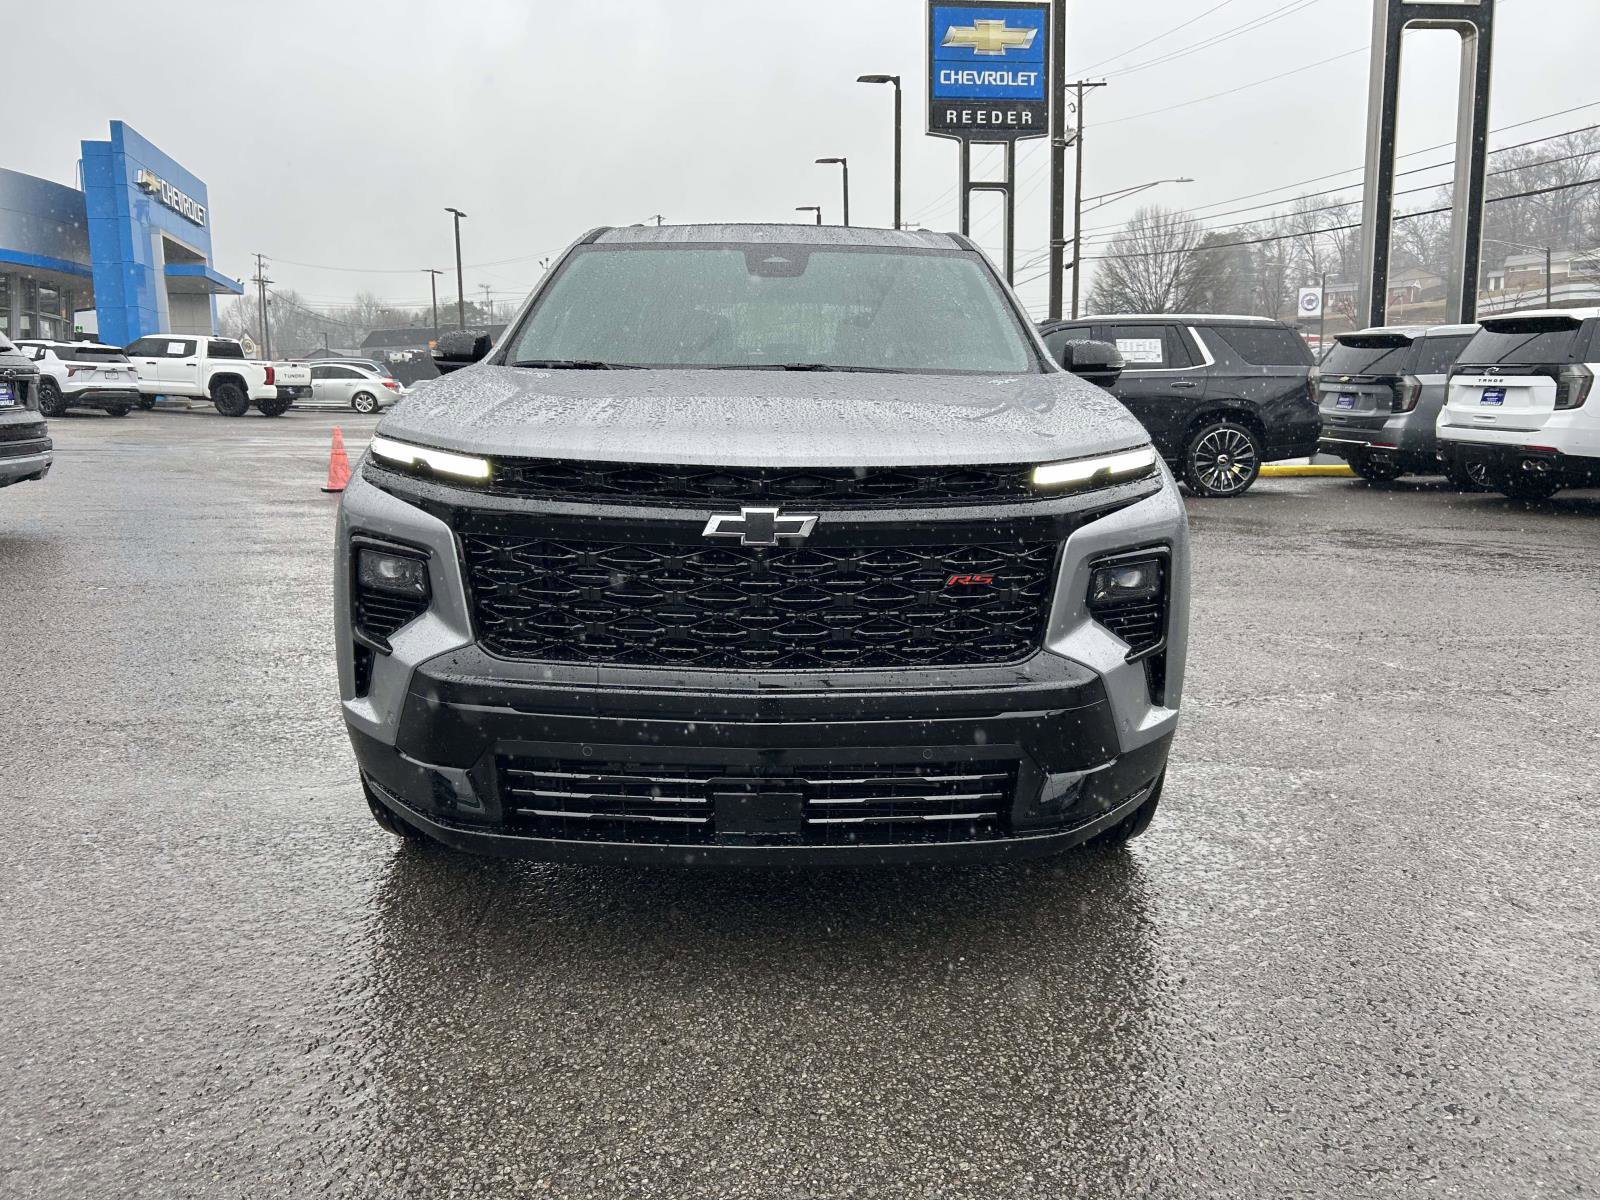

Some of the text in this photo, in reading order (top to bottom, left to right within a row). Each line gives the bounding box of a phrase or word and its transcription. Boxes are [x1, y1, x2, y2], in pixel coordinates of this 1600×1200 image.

[940, 70, 1038, 86] CHEVROLET
[946, 110, 1032, 125] REEDER
[161, 179, 206, 227] CHEVROLET
[946, 574, 993, 586] RS
